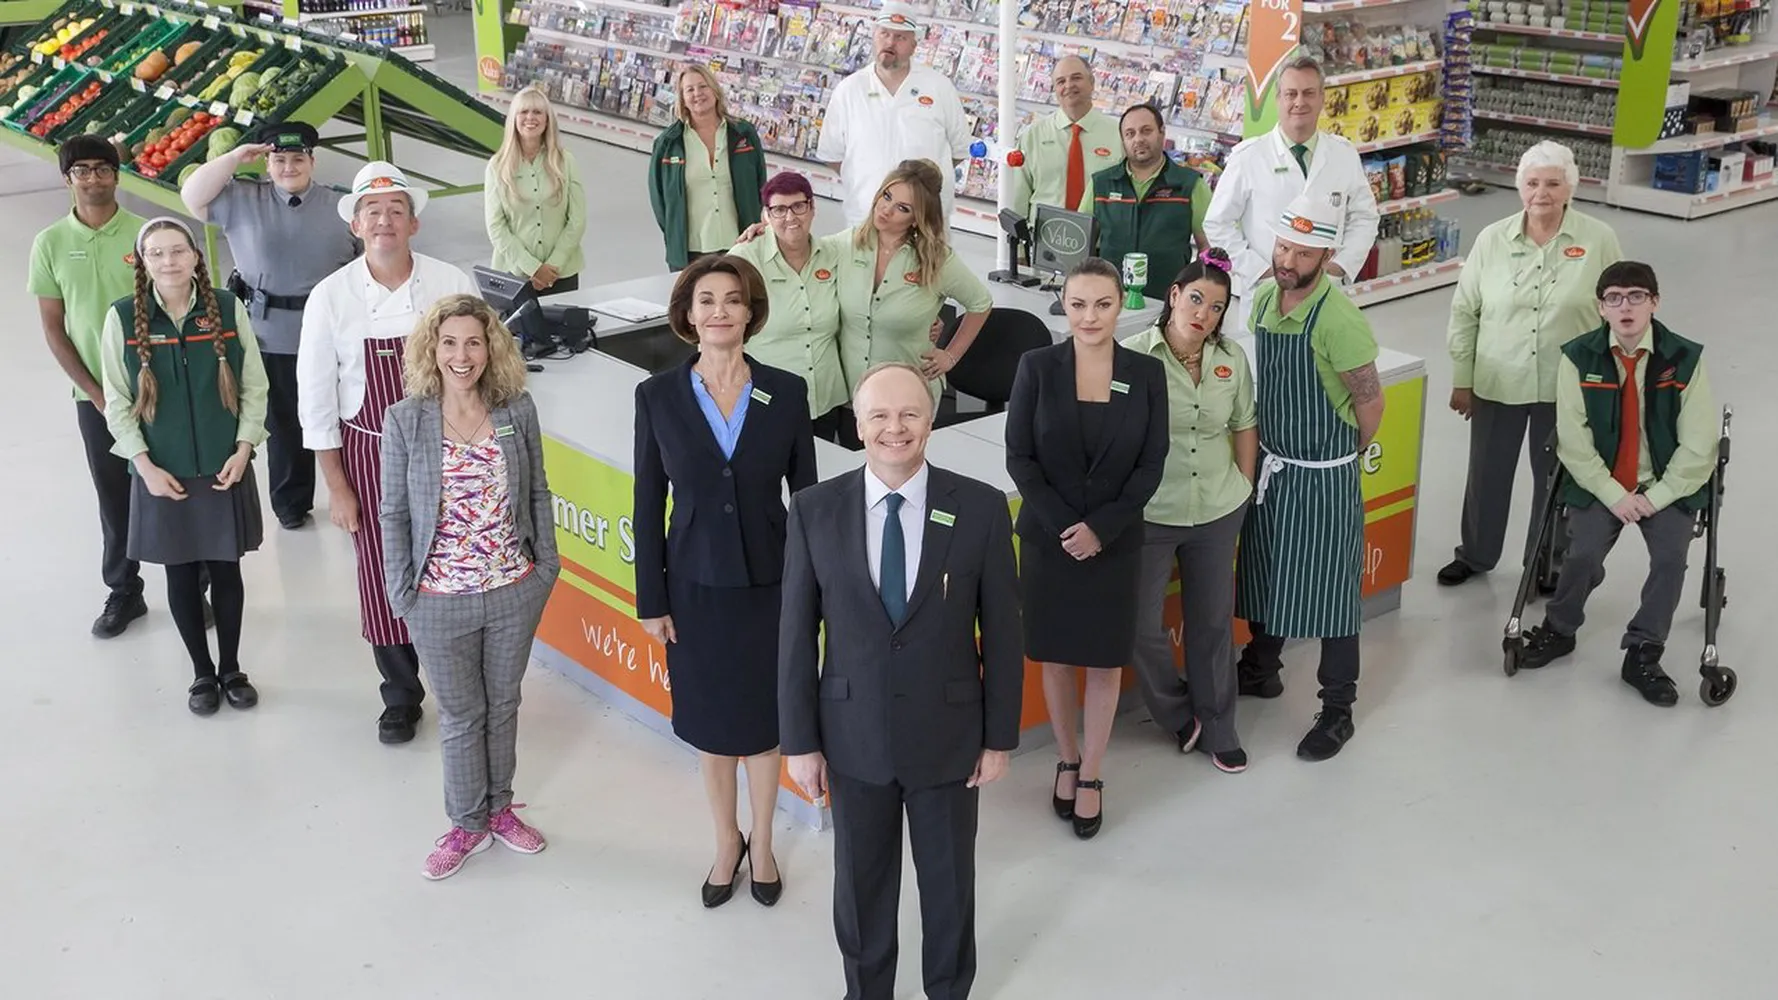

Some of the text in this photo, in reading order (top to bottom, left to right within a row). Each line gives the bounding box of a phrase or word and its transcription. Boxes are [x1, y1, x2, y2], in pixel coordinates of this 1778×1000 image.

[1280, 11, 1298, 41] 2
[1046, 222, 1080, 250] Valco
[580, 616, 637, 671] We're
